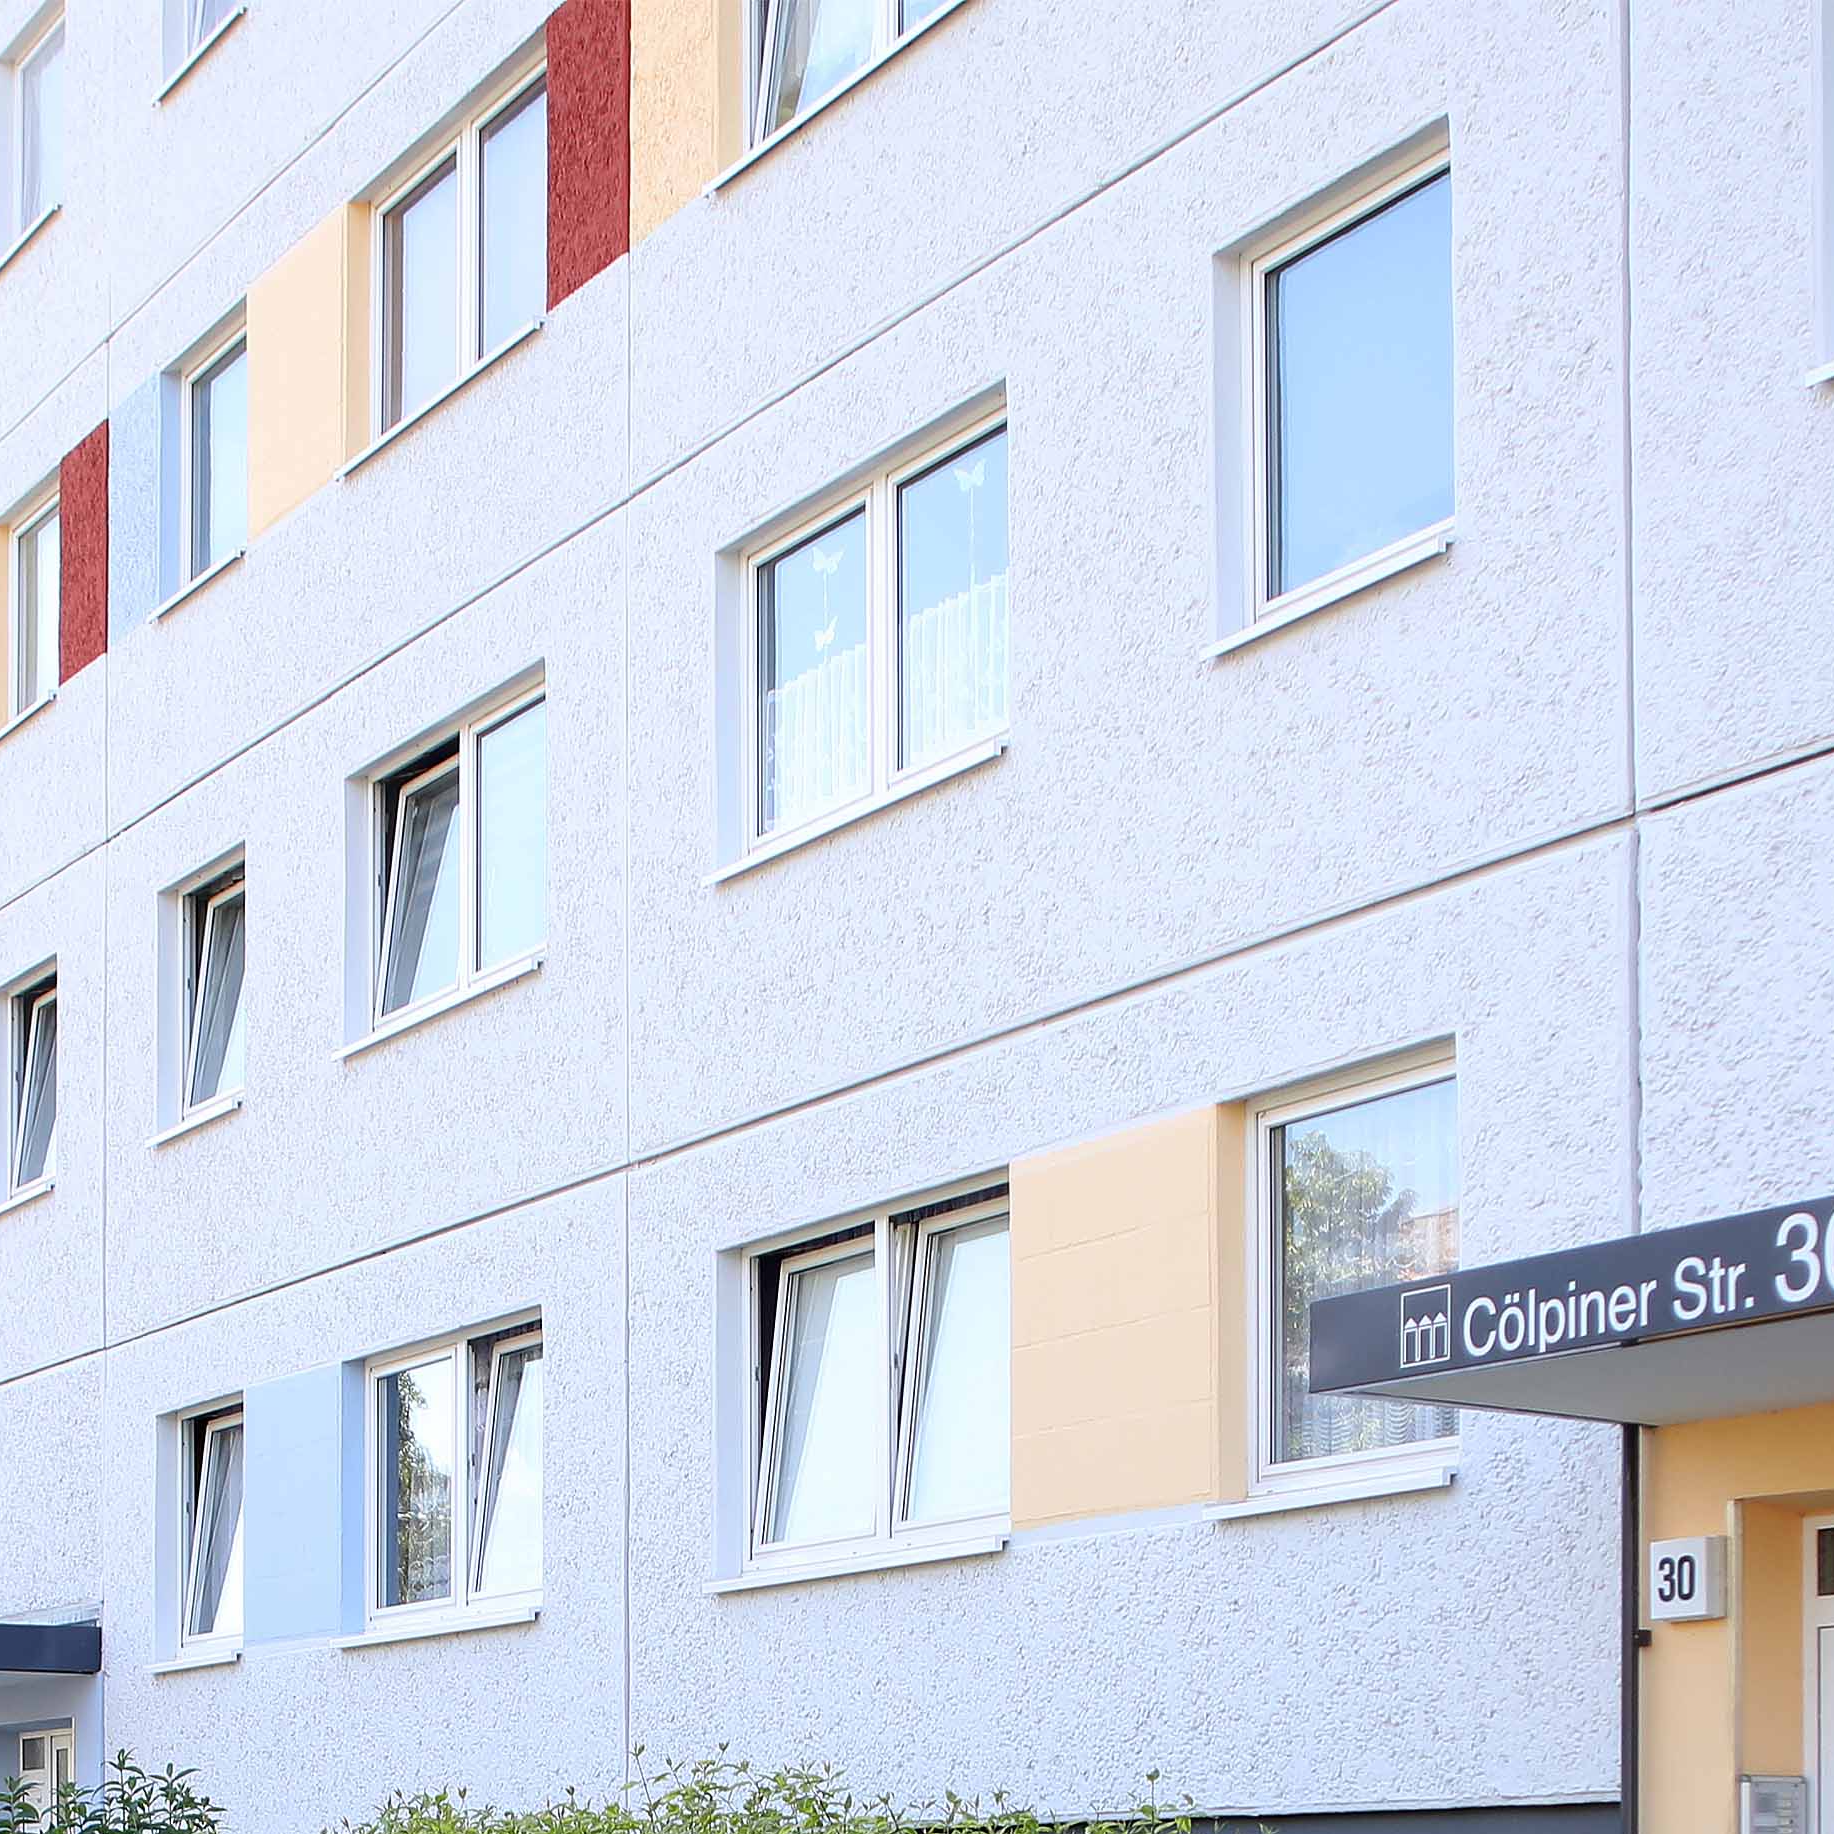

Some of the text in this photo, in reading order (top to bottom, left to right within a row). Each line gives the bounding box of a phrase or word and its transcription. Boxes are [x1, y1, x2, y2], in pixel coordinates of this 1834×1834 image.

[1463, 1280, 1658, 1357] Cölpiner
[1673, 1256, 1754, 1321] Str.
[1658, 1555, 1696, 1602] 30
